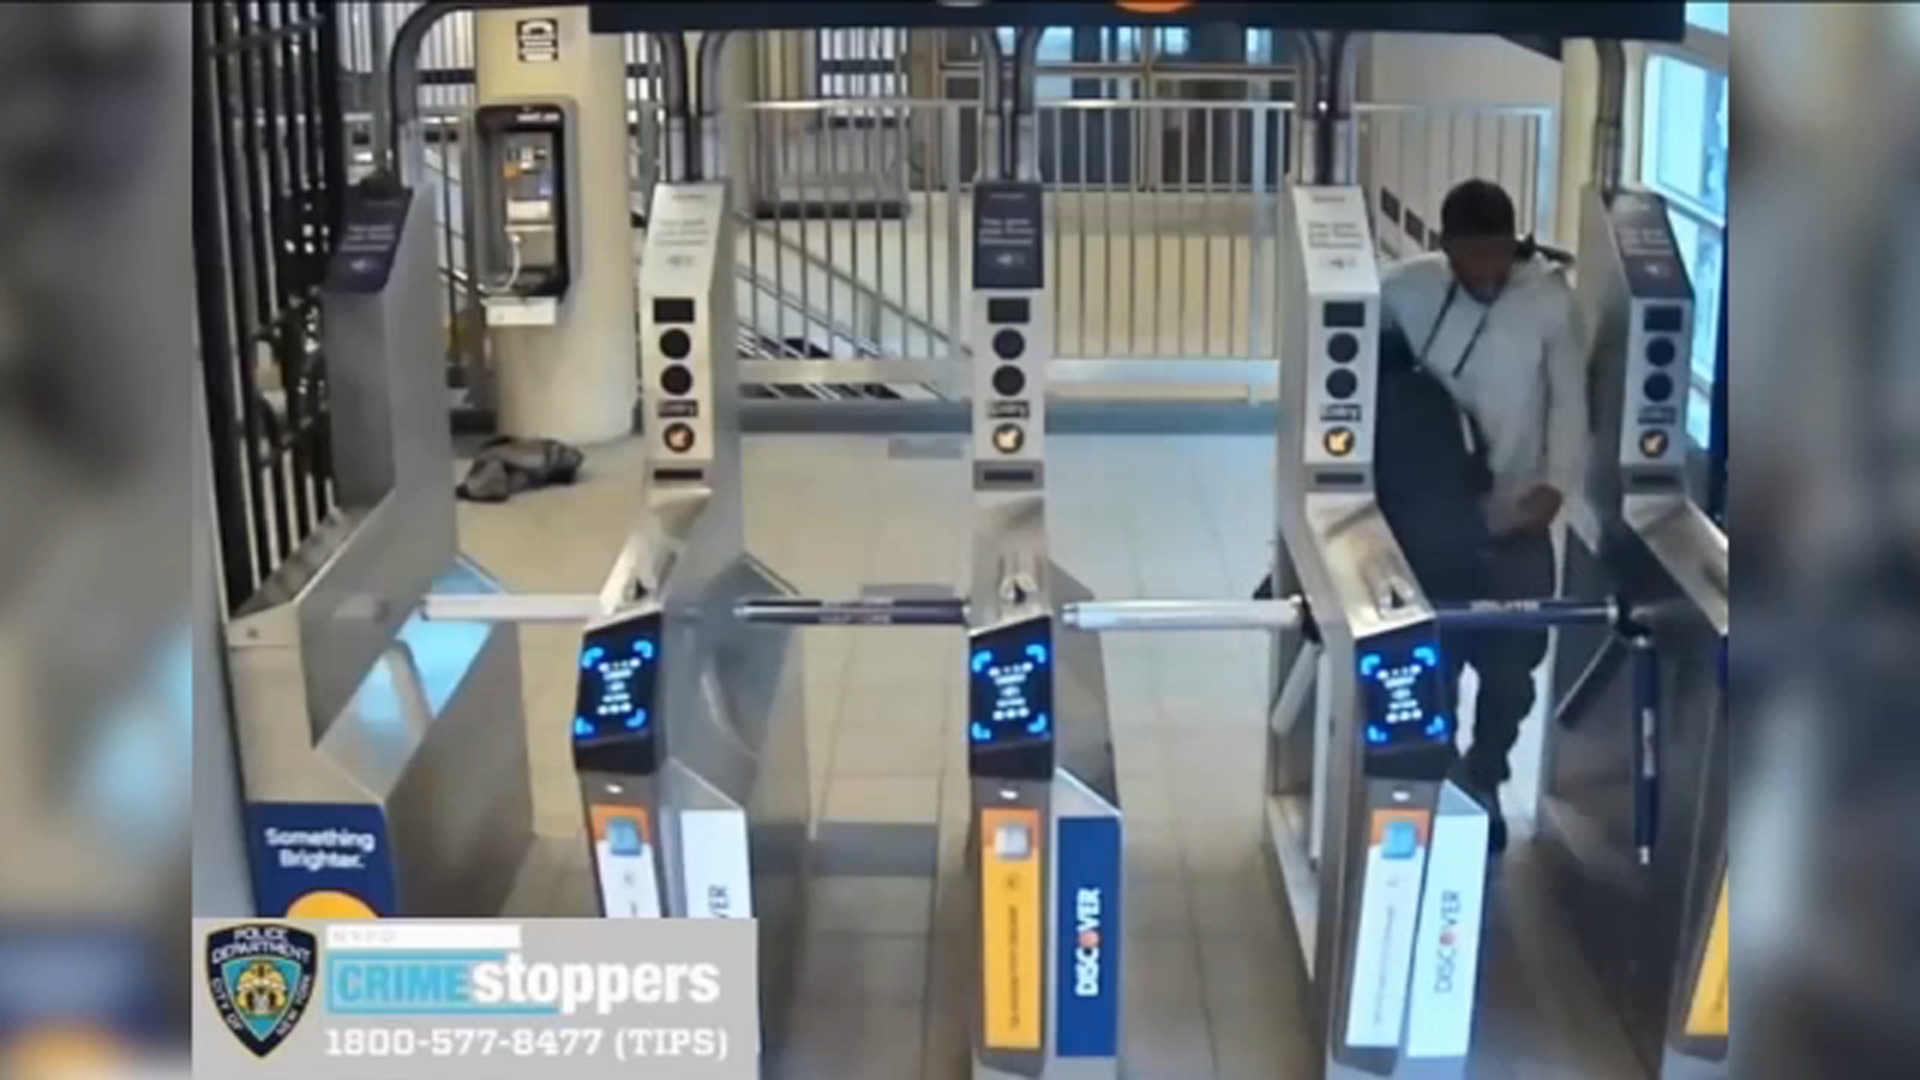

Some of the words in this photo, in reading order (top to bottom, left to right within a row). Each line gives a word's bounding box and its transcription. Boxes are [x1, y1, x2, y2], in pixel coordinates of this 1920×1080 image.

[264, 827, 376, 852] Something
[280, 848, 366, 871] Brighter.
[1075, 887, 1101, 996] DISCOVER
[1433, 889, 1461, 993] DISCOVER
